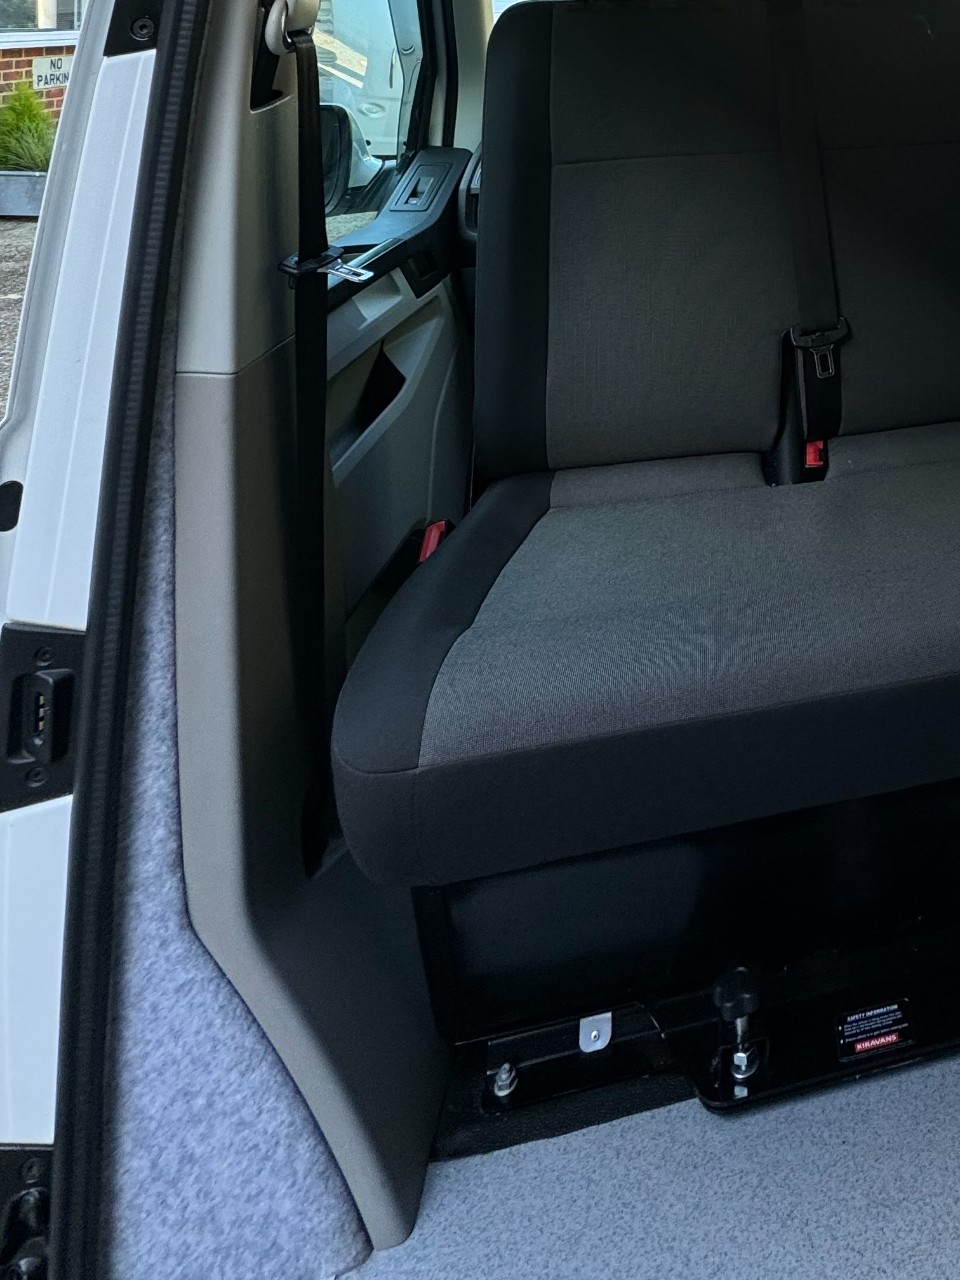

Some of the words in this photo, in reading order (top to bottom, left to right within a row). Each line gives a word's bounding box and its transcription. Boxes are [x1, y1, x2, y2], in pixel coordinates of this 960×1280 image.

[50, 58, 63, 70] NO
[36, 71, 70, 87] PARKIN
[847, 1012, 866, 1022] SAFETY
[866, 1004, 899, 1017] INFORMATION
[856, 1034, 897, 1050] KIRAVANS
